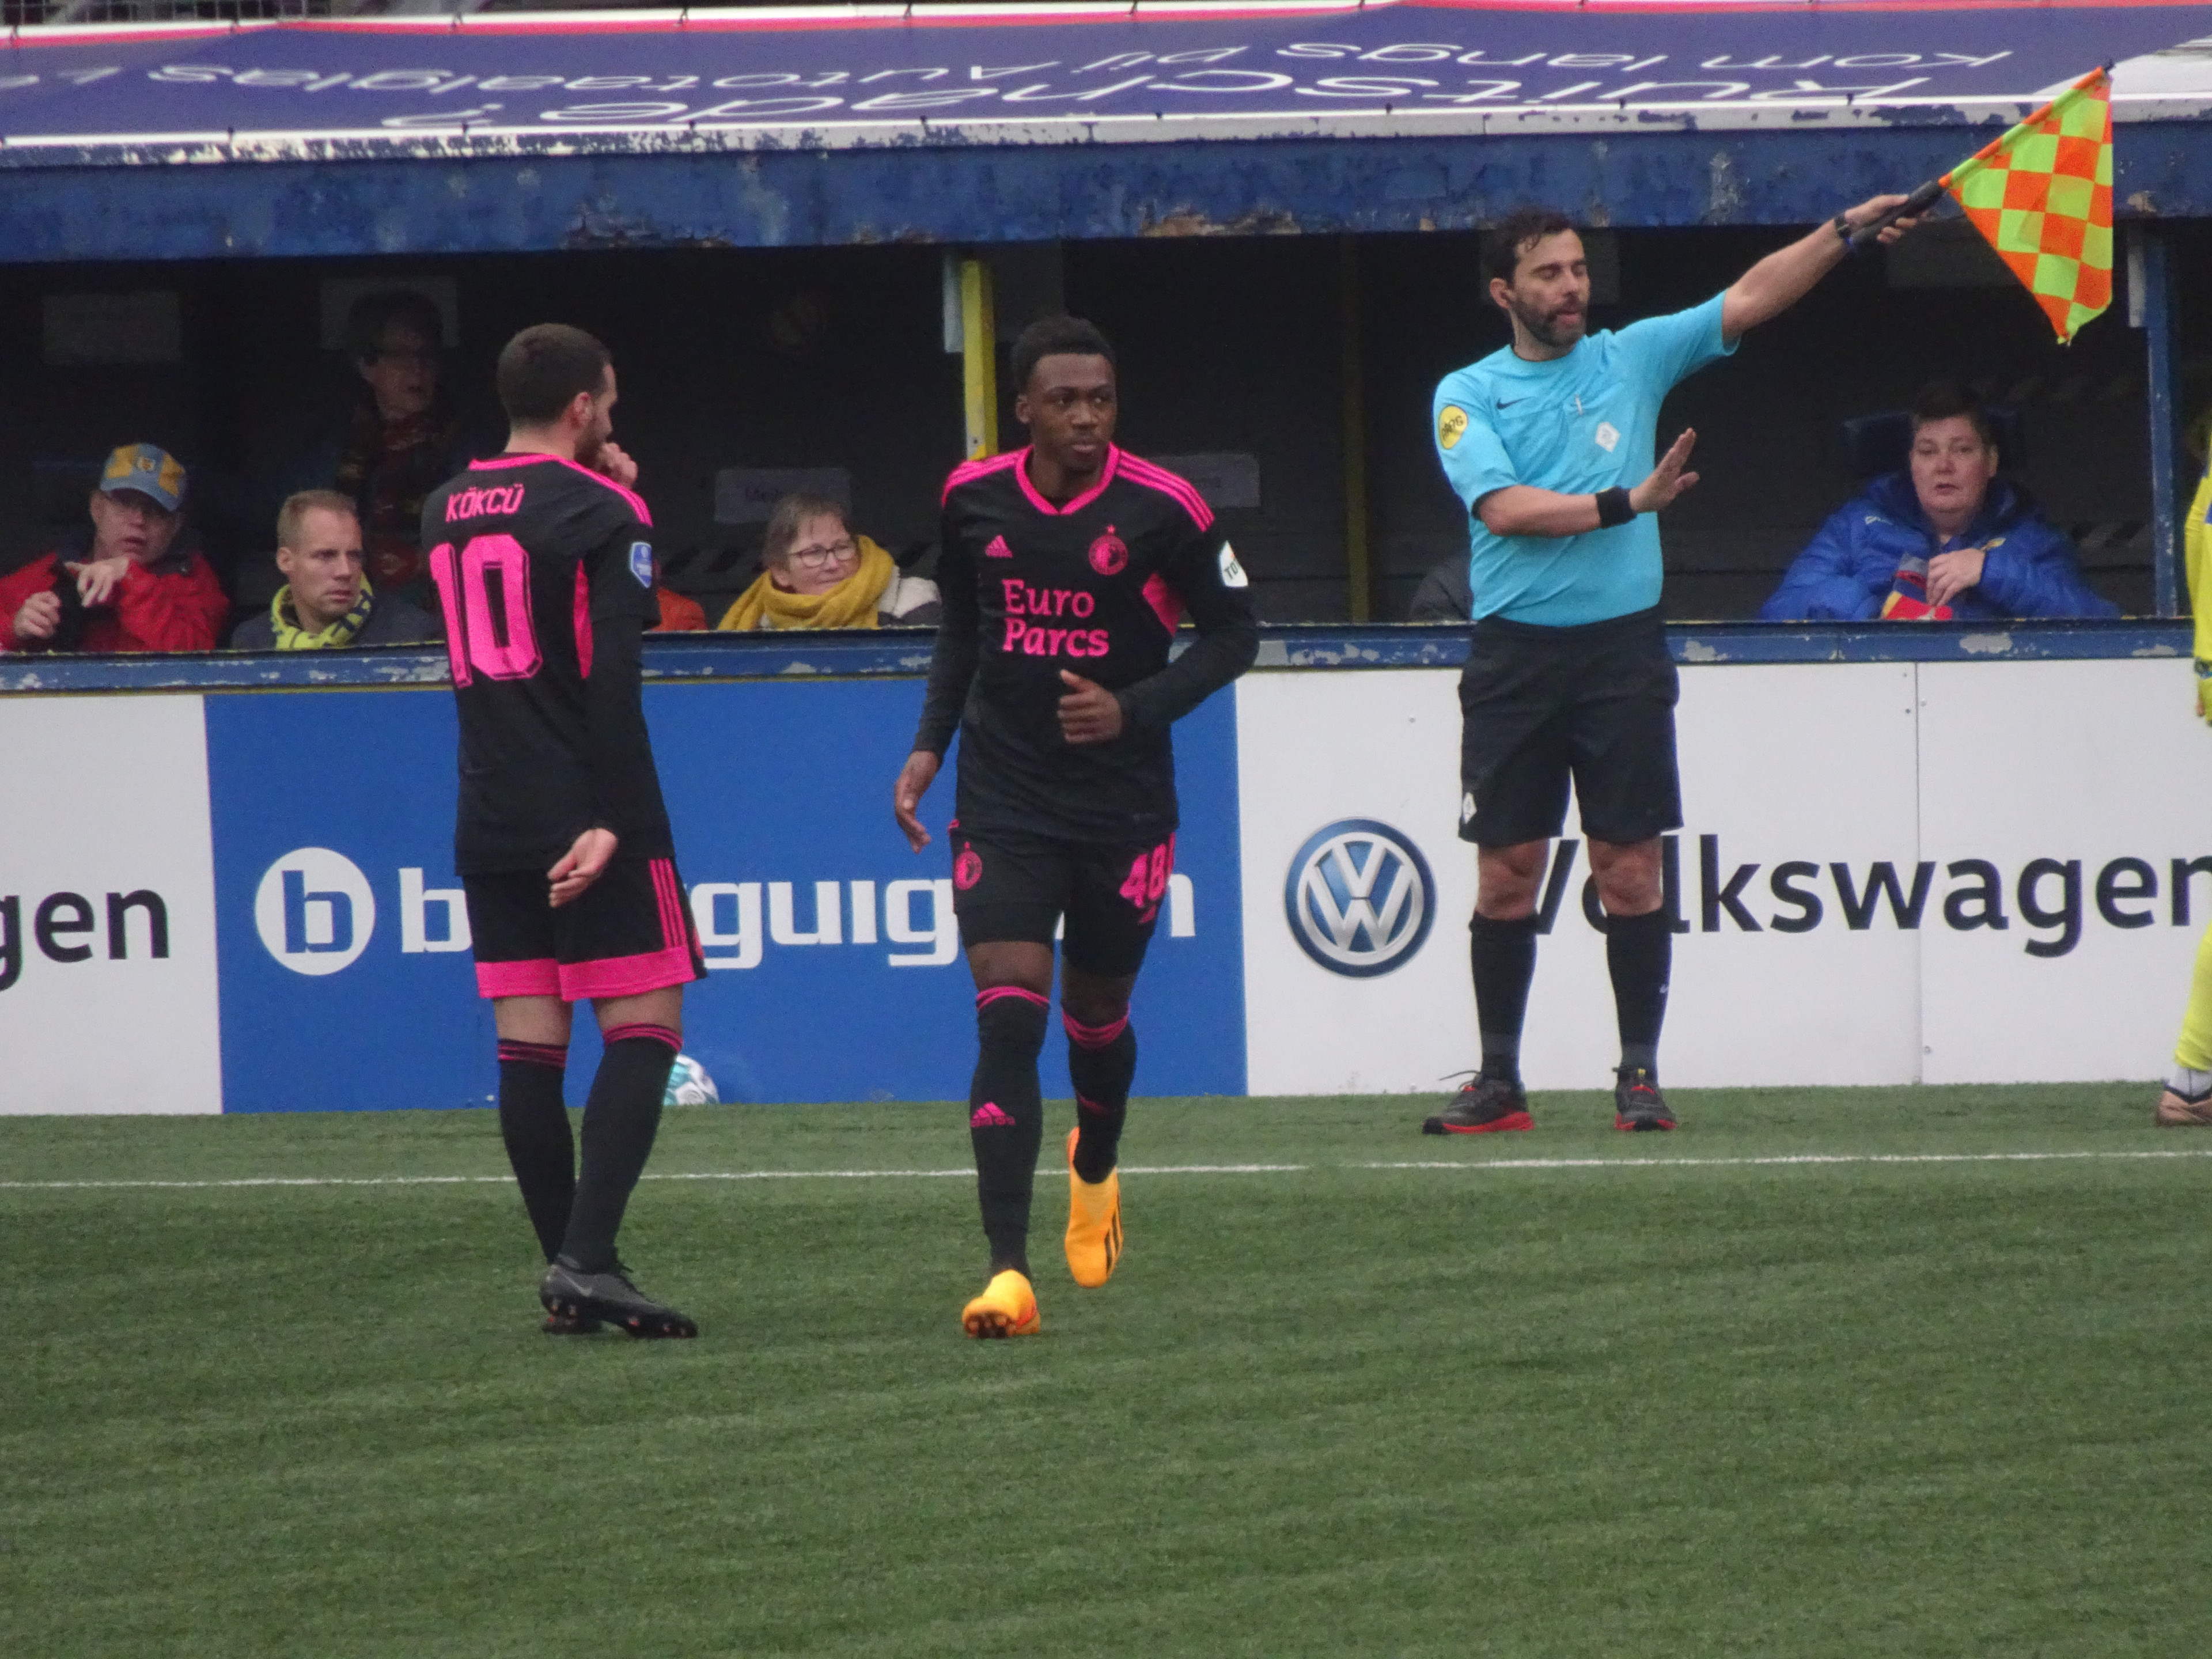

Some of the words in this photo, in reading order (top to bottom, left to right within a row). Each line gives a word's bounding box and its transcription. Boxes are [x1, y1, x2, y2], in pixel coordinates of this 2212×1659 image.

[1277, 43, 1668, 71] langs
[148, 62, 1063, 93] Autotaalglas
[382, 69, 1931, 126] Ruitschade?
[429, 533, 543, 689] 10
[1002, 578, 1094, 618] Euro
[1002, 618, 1109, 657] Parcs
[1119, 843, 1167, 908] 48
